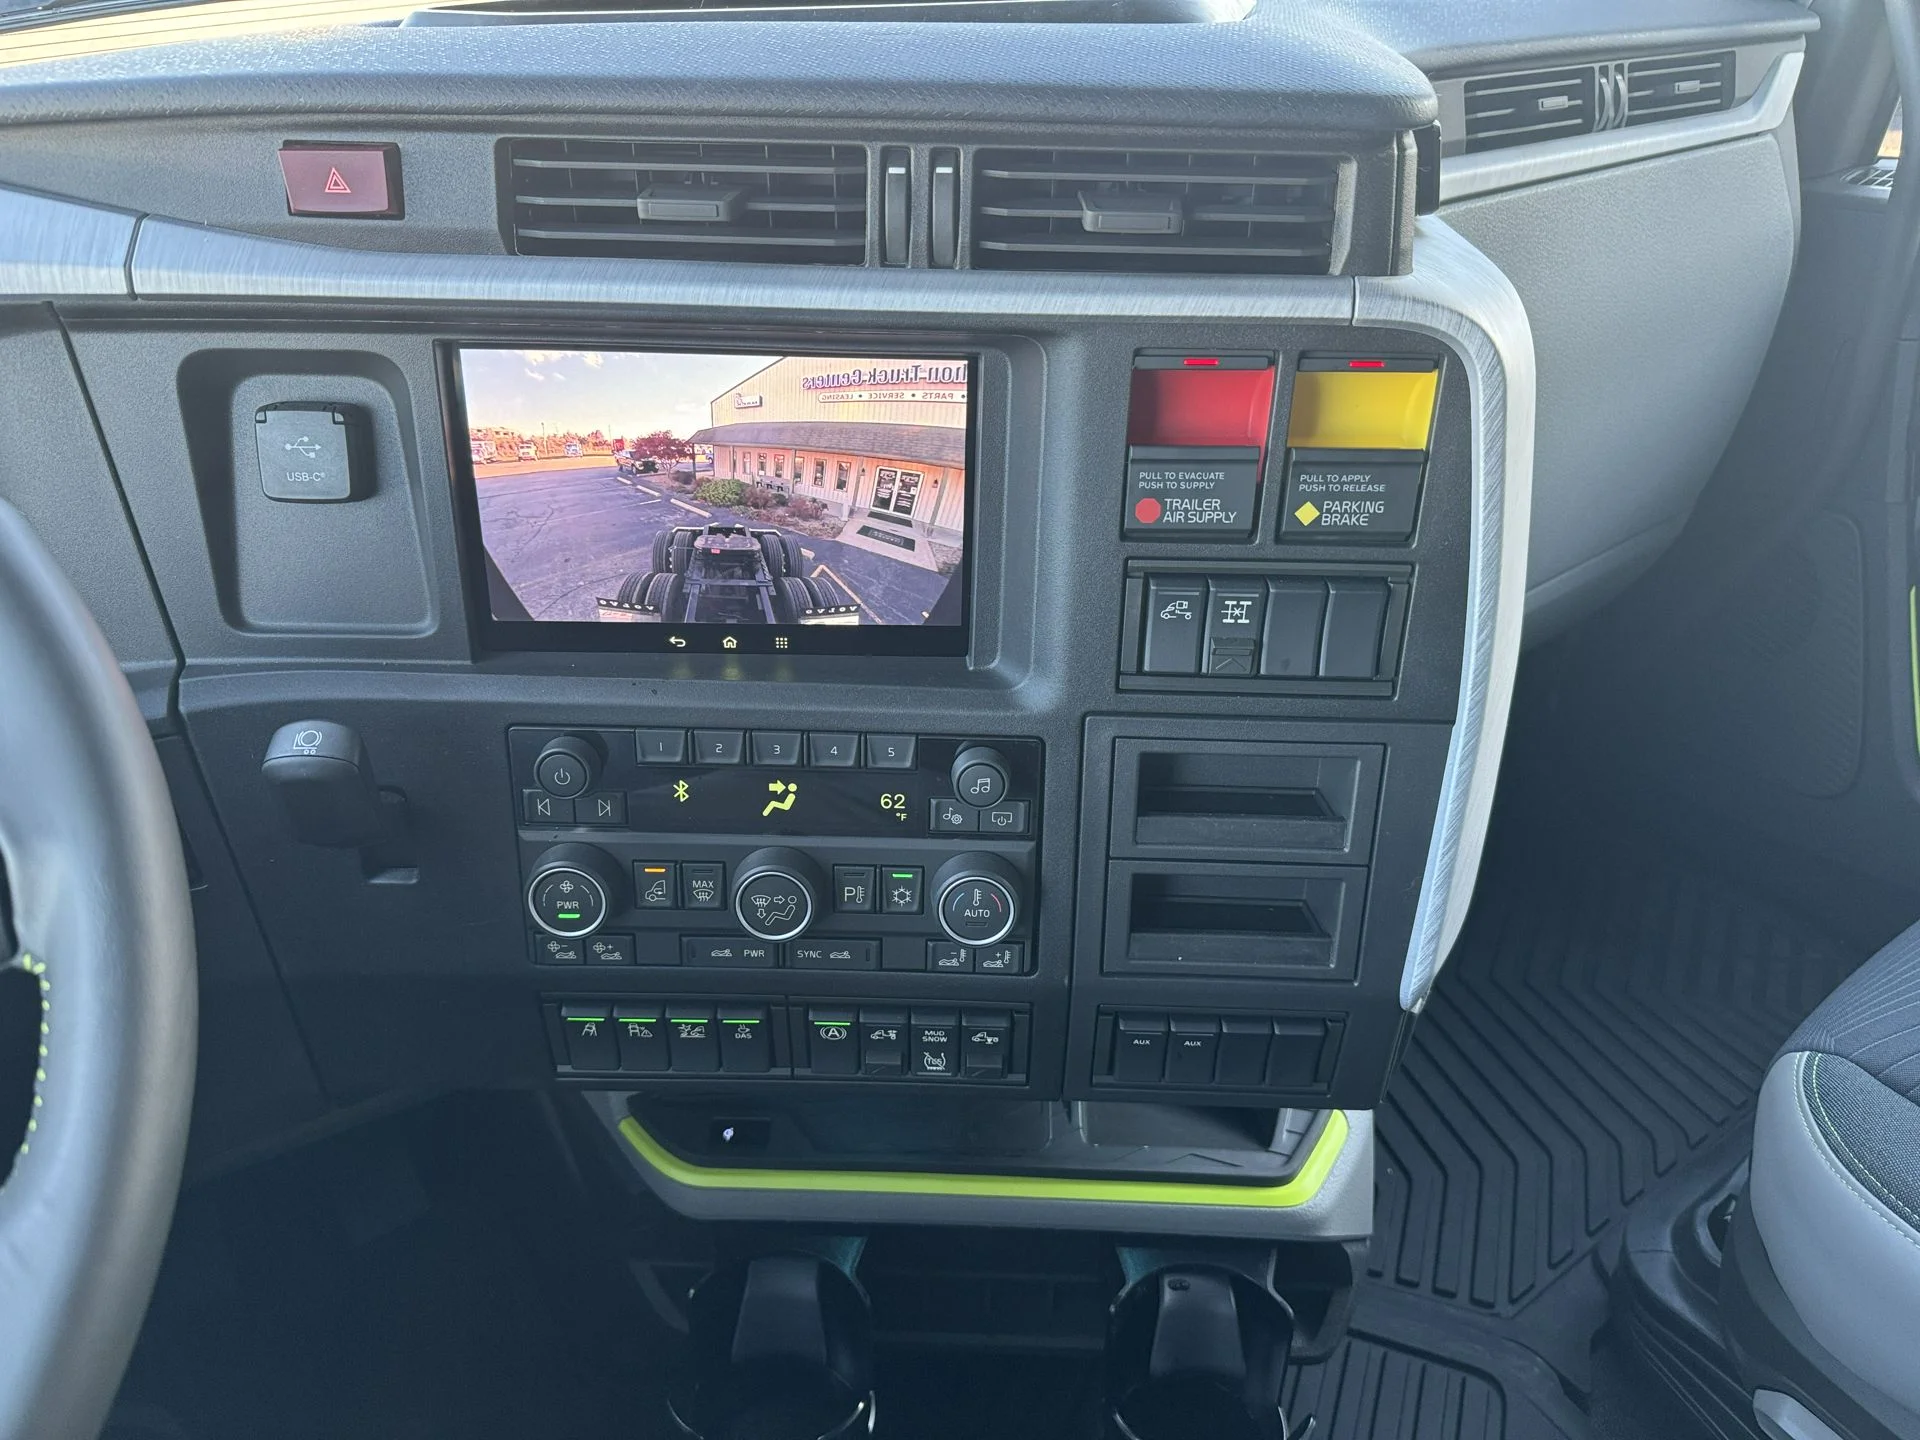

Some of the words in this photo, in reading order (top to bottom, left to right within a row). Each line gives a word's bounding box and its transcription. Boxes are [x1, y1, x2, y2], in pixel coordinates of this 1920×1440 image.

[1139, 471, 1162, 480] PULL
[1164, 471, 1176, 480] TO
[1178, 471, 1225, 480] EVACUATE
[1299, 474, 1324, 483] PULL
[1326, 474, 1340, 483] TO
[1340, 474, 1372, 483] APPLY
[1138, 481, 1163, 490] PUSH
[1165, 481, 1178, 490] TO
[1179, 481, 1216, 490] SUPPLY
[1298, 484, 1326, 493] PUSH
[1327, 484, 1341, 493] TO
[1342, 483, 1386, 493] RELEASE
[1163, 498, 1221, 511] TRAILER
[1322, 500, 1385, 514] PARKING
[1162, 511, 1185, 524] AIR
[1186, 511, 1237, 524] SUPPLY
[1321, 513, 1370, 526] BRAKE
[715, 743, 723, 754] 2
[773, 744, 781, 755] 3
[829, 745, 838, 756] 4
[887, 747, 895, 758] 5
[879, 792, 906, 810] 62
[692, 879, 714, 888] MAX
[556, 900, 580, 910] PWR
[963, 908, 990, 919] AUTO
[743, 949, 765, 959] PWR
[796, 950, 823, 959] SYNC
[735, 1032, 752, 1040] DAS
[1184, 1039, 1202, 1047] AUX
